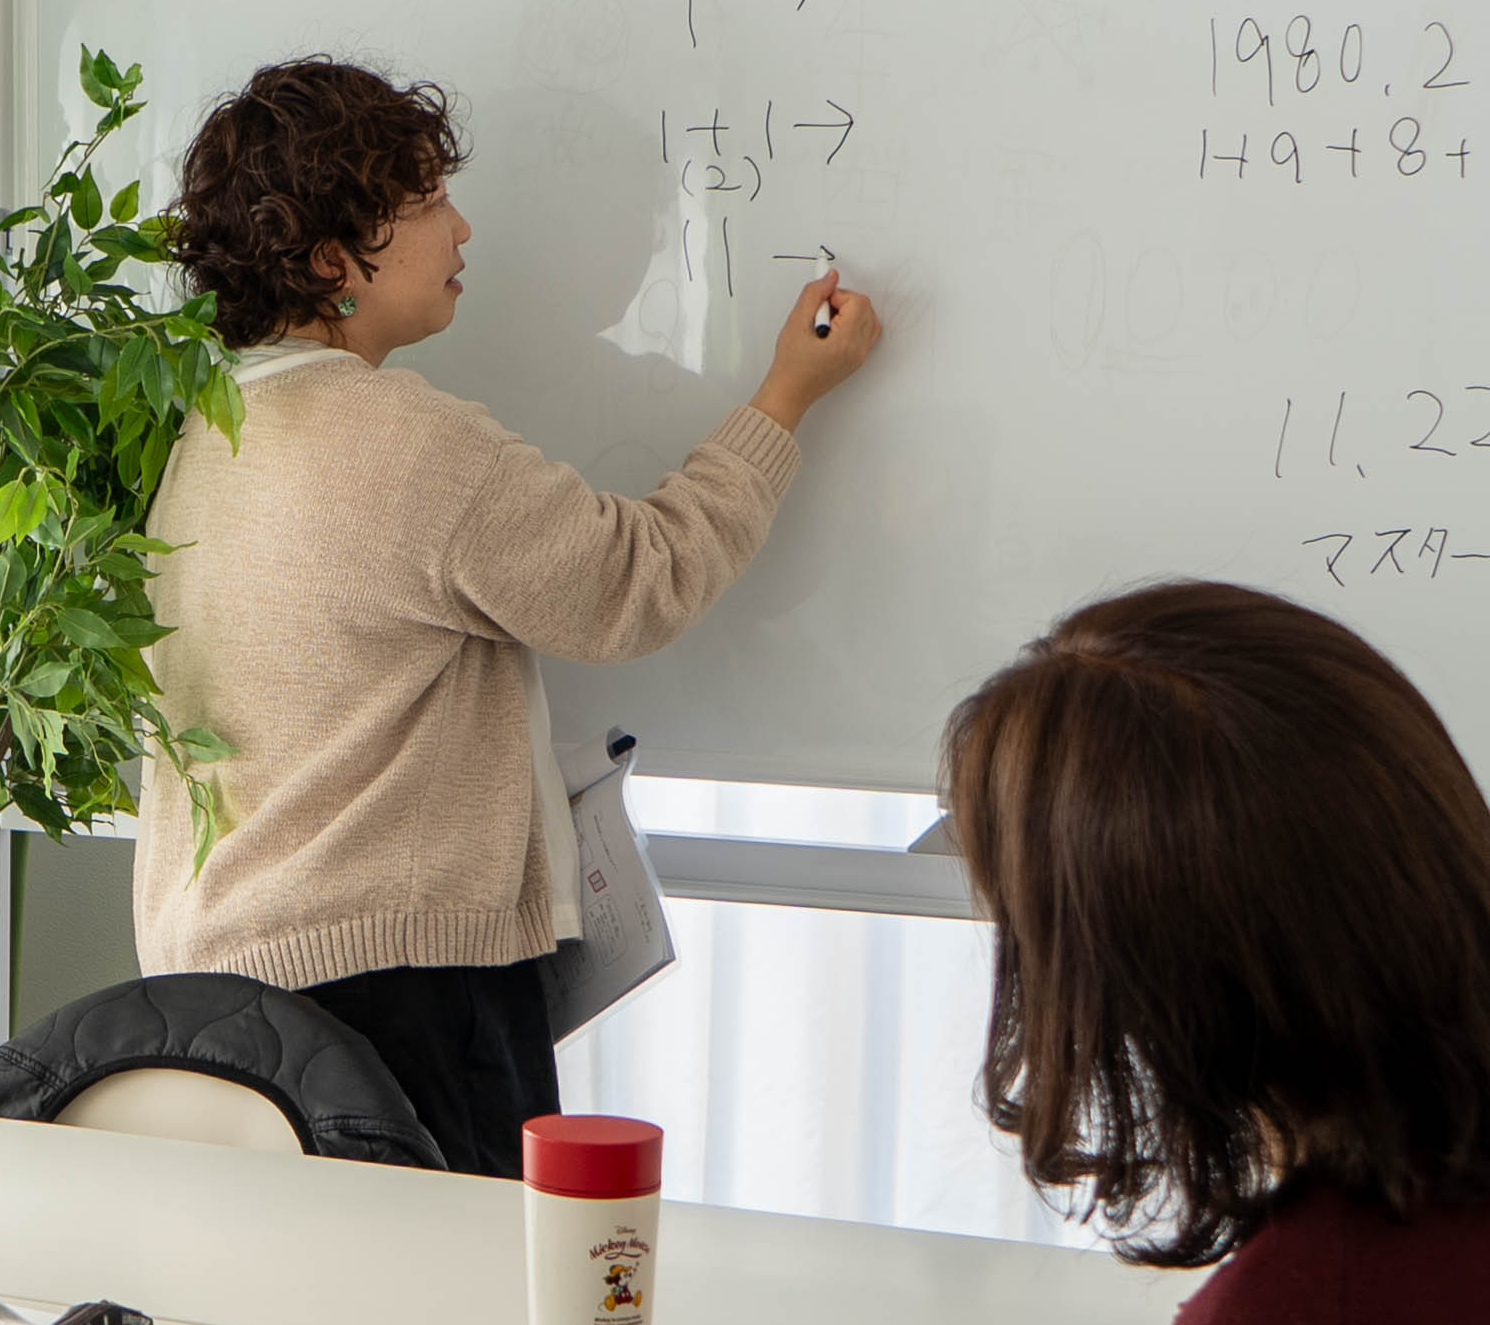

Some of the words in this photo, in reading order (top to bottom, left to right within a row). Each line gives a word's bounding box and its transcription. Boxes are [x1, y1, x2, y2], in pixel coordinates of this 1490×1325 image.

[681, 155, 762, 202] (2)
[683, 215, 734, 298] 11
[589, 1239, 626, 1259] Mickey
